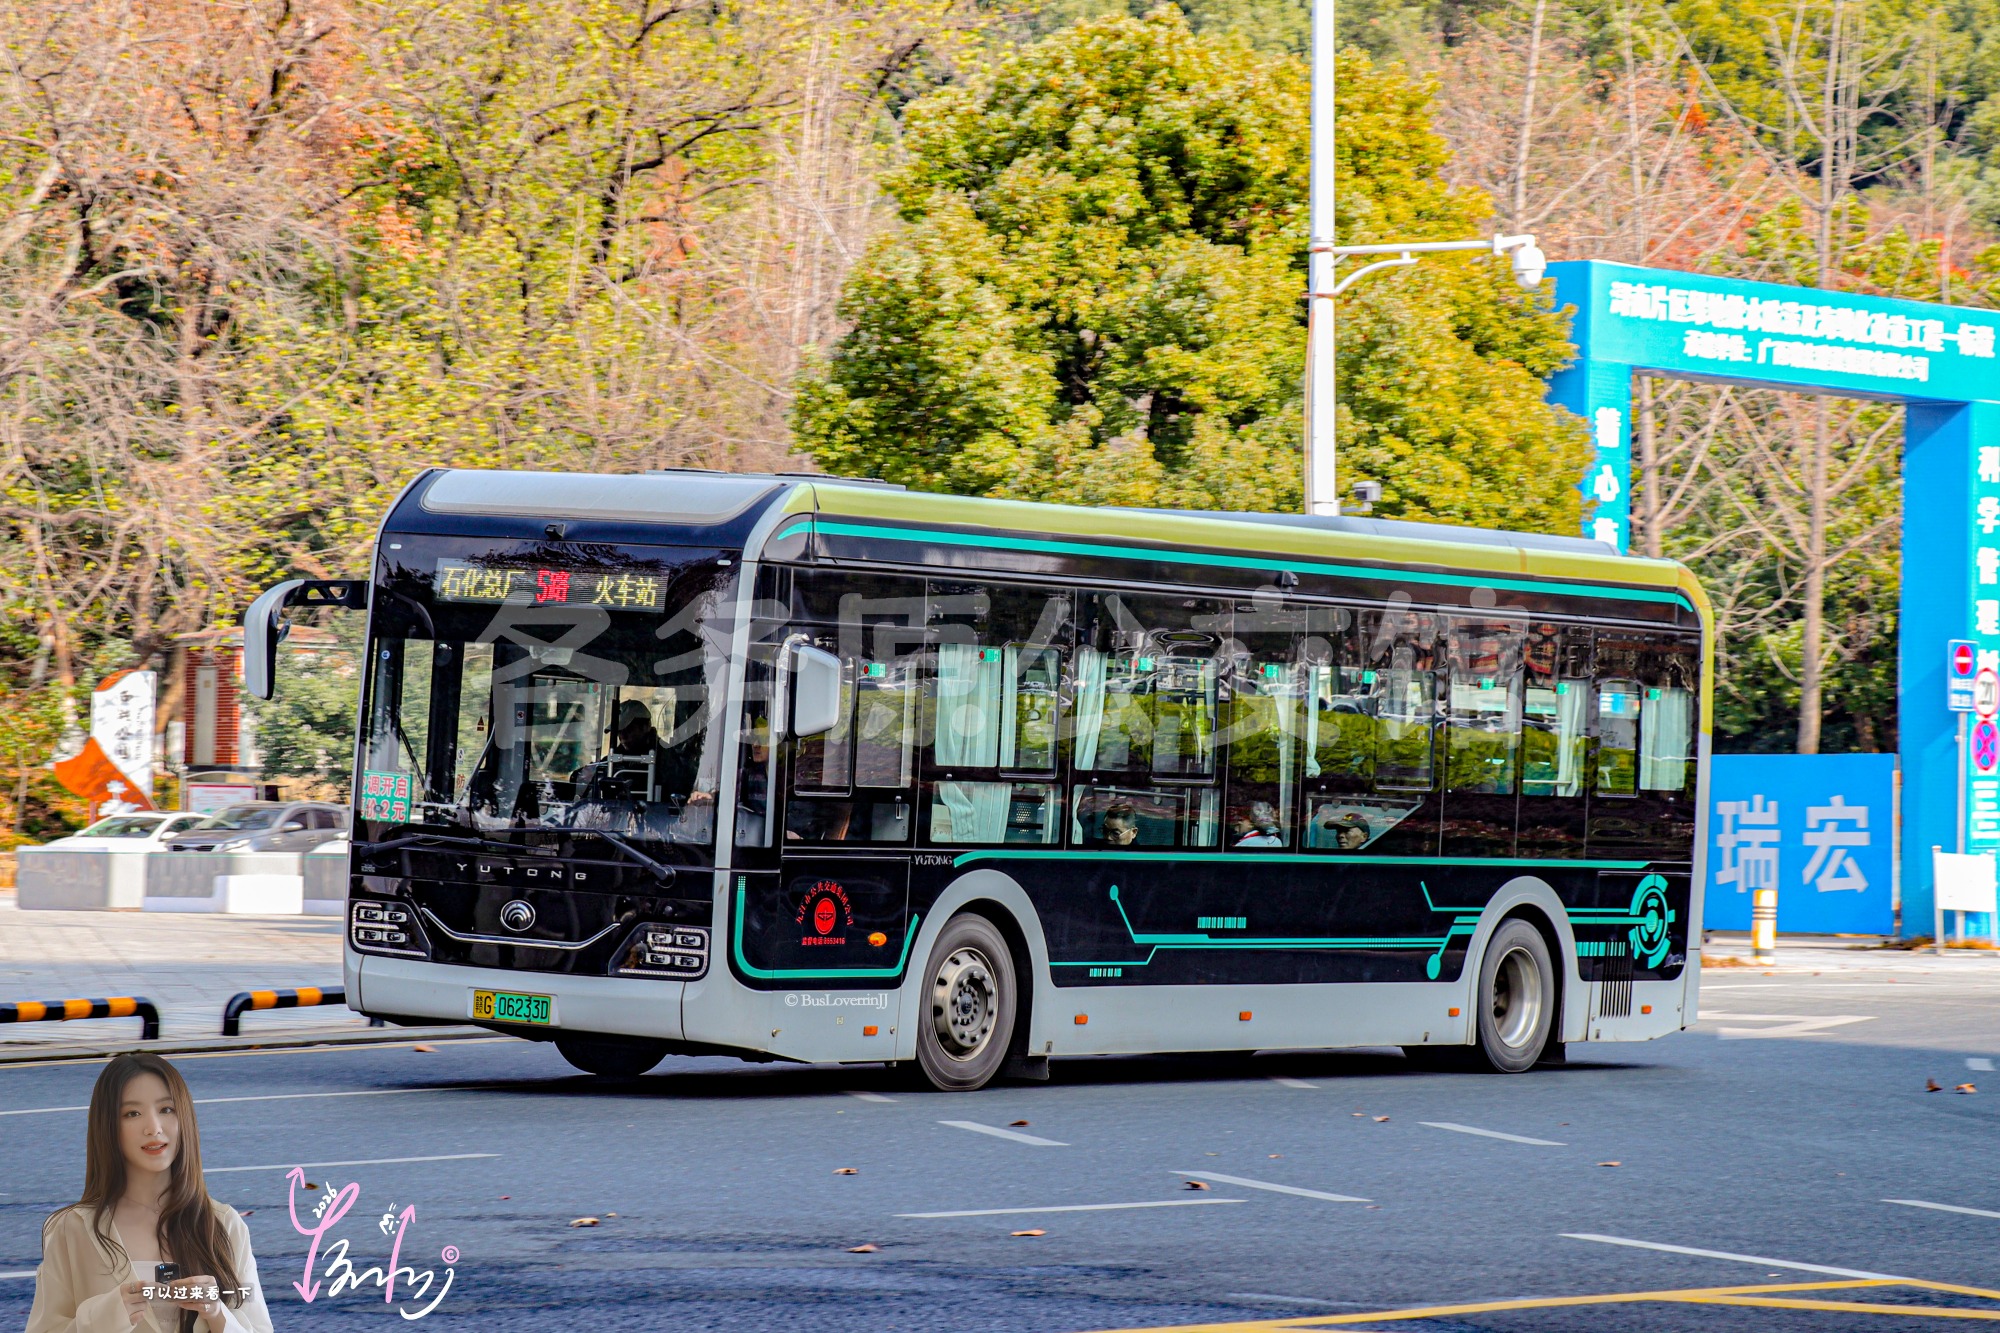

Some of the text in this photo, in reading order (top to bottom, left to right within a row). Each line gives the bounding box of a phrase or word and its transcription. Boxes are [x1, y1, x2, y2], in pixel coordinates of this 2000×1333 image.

[441, 566, 659, 607] 石化总厂 5路 火车站
[1716, 794, 1870, 893] 瑞宏
[457, 862, 587, 880] YUTONG
[914, 855, 953, 866] YUTONG
